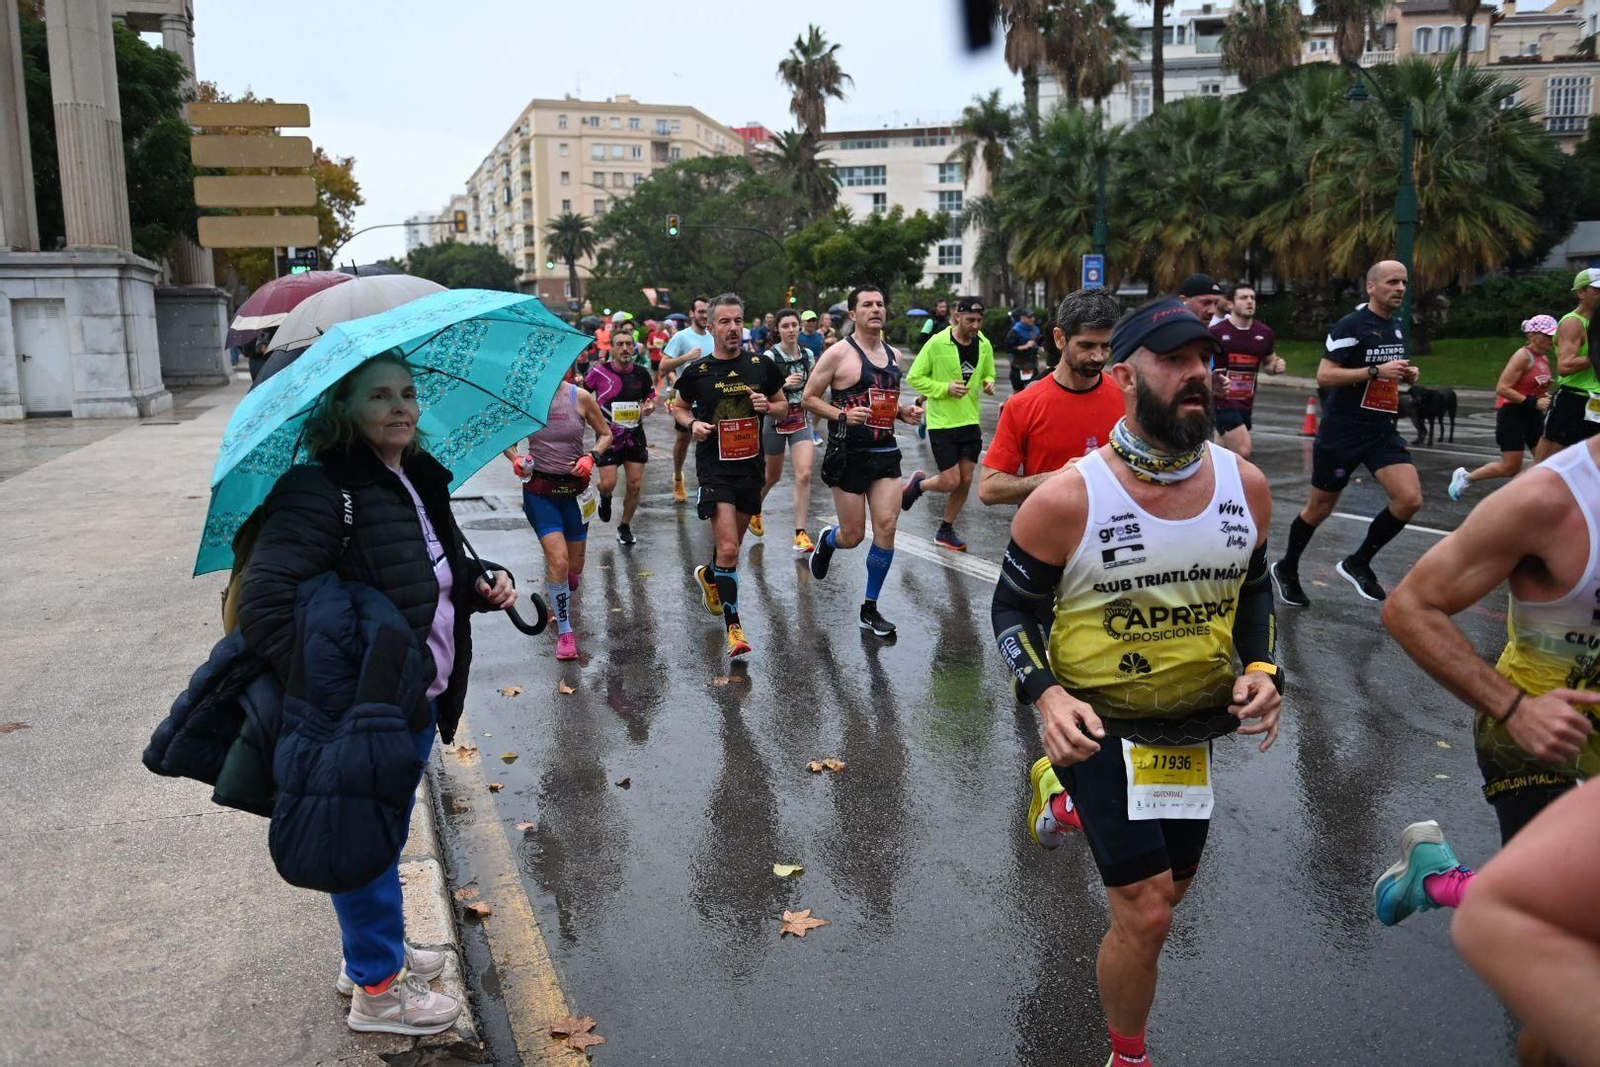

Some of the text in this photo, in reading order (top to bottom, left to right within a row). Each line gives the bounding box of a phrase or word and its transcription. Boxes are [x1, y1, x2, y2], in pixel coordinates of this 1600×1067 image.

[1098, 522, 1141, 542] gross
[1092, 578, 1132, 593] CLUB
[1134, 562, 1210, 588] TRIATLÓN
[1121, 625, 1211, 641] OPOSICIONES
[1564, 630, 1600, 651] CLU
[1003, 635, 1022, 659] CLUB
[1153, 754, 1191, 770] 11936
[1527, 773, 1566, 784] MALA
